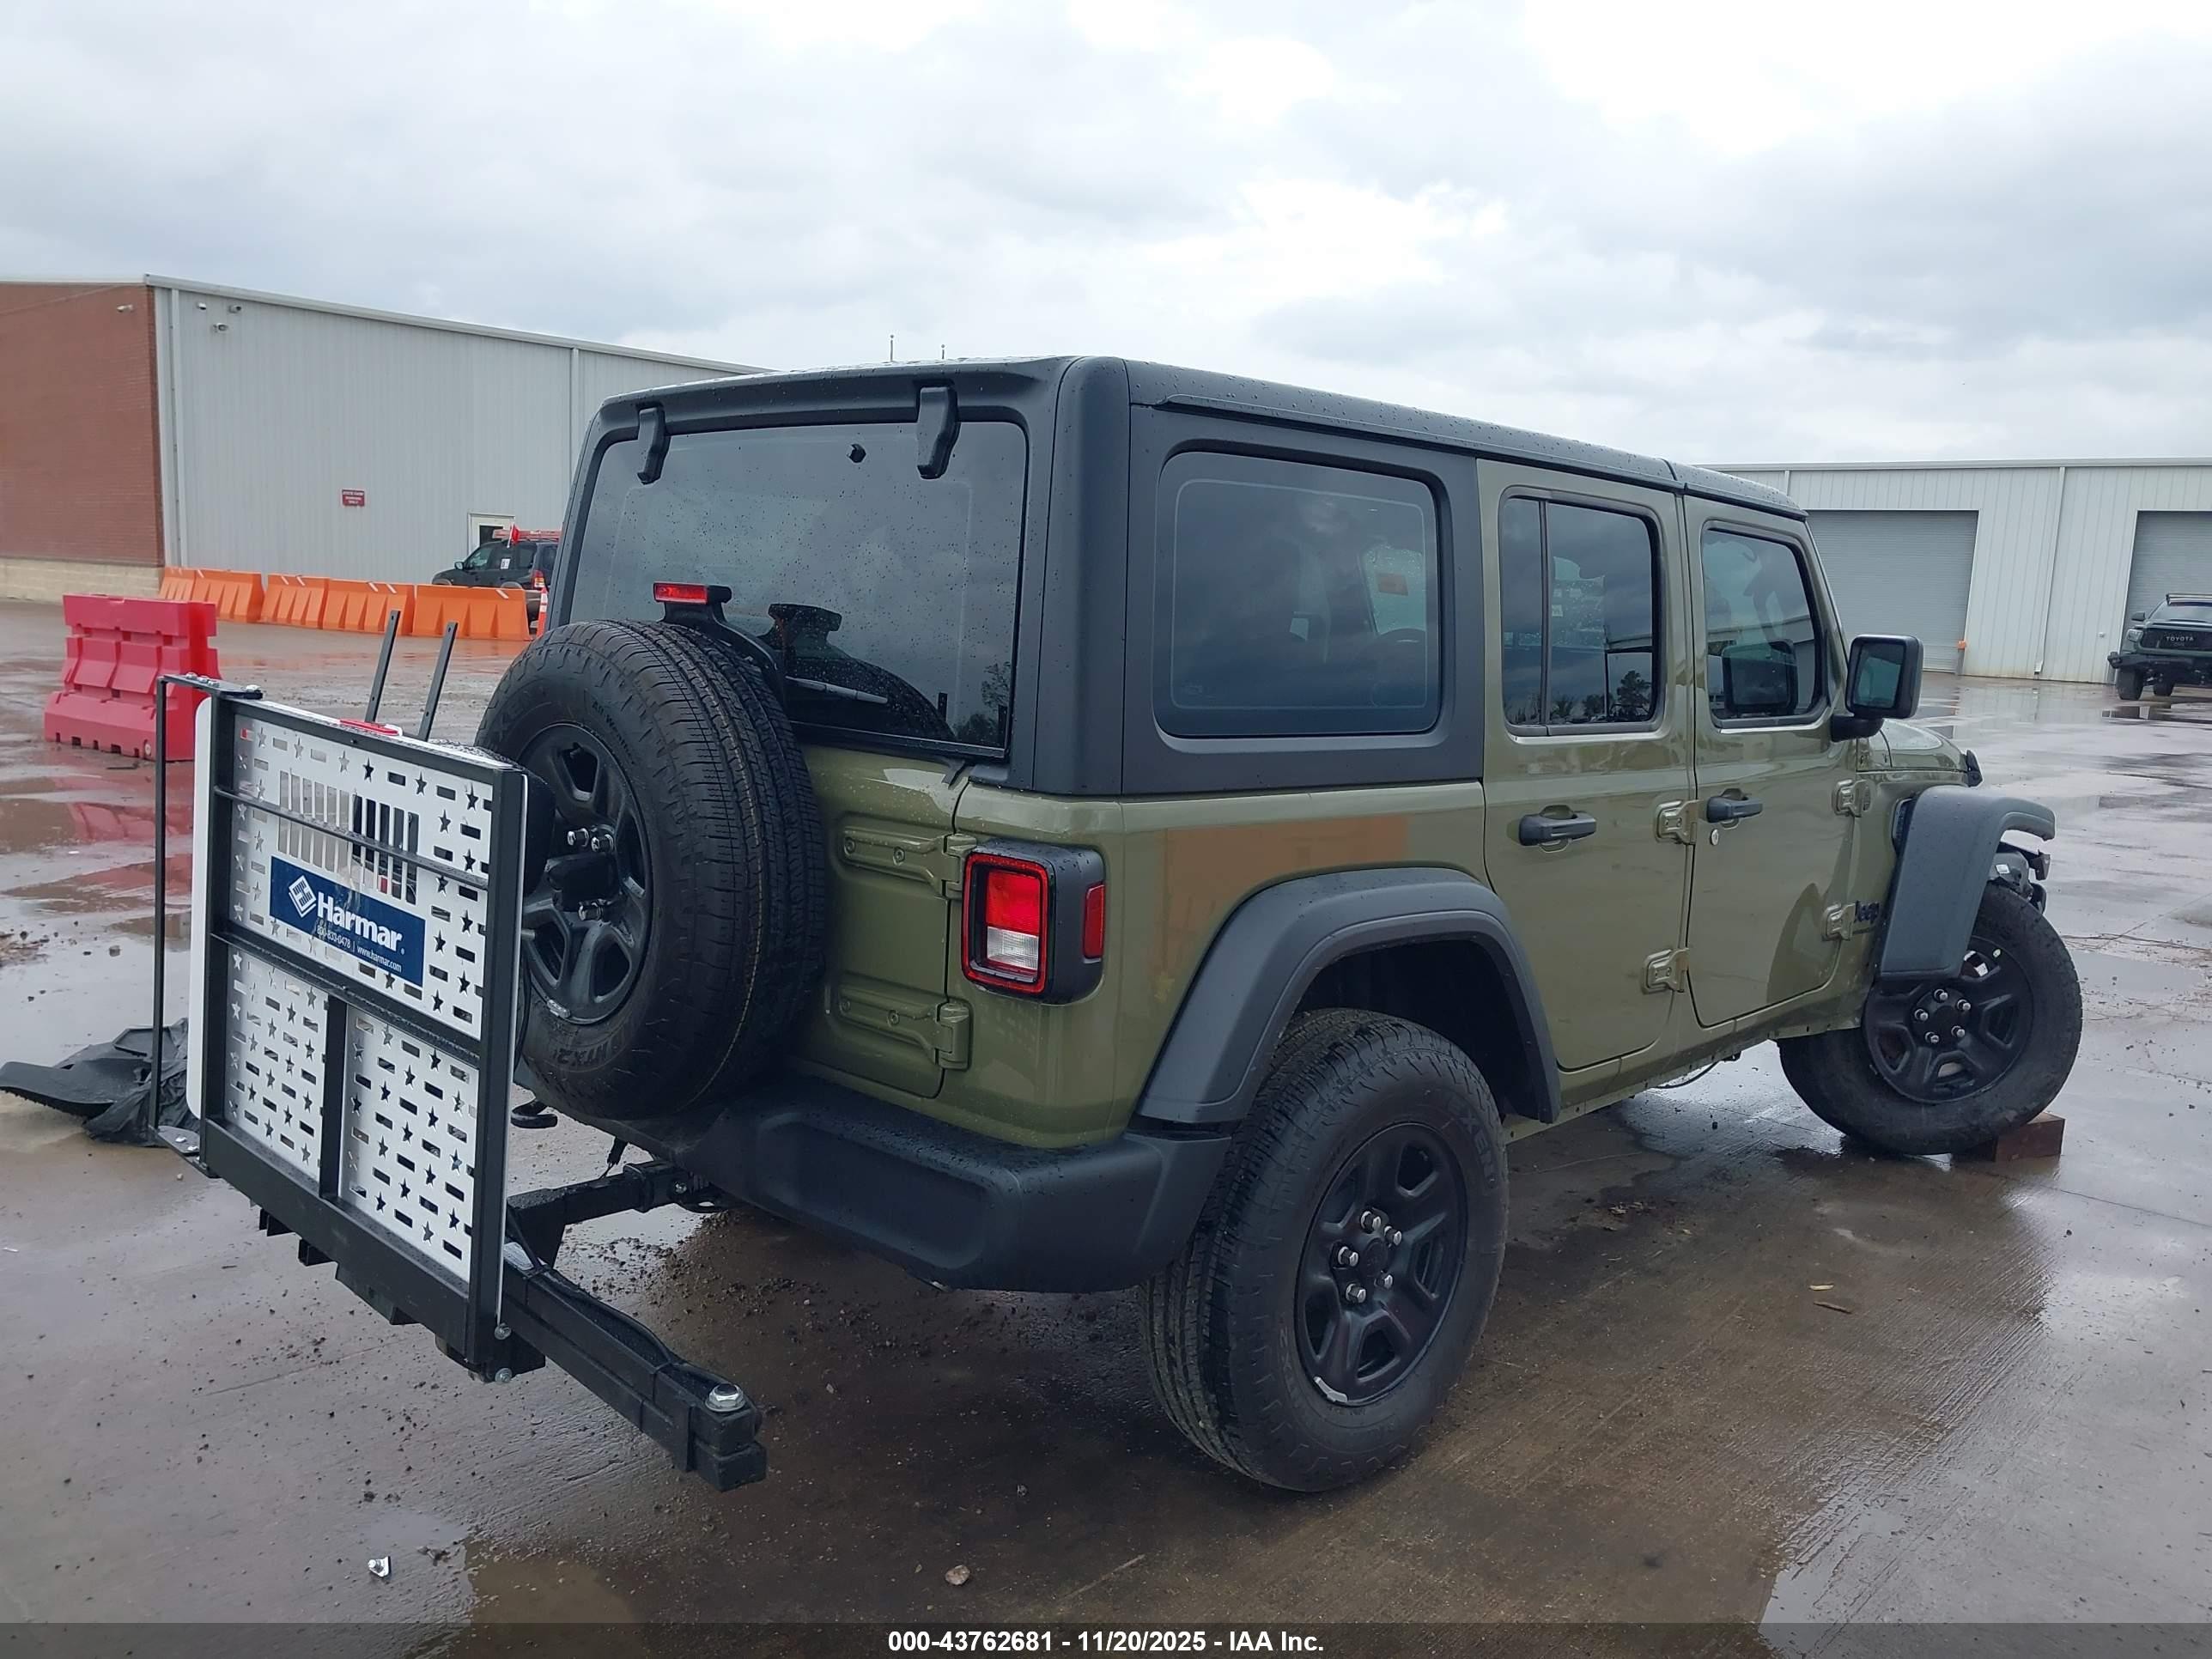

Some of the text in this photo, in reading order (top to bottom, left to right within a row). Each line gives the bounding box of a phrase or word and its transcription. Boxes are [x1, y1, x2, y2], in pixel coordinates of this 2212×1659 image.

[317, 891, 404, 952] Harmar
[1855, 900, 1880, 925] Jeep
[356, 945, 402, 973] www.harmar.com
